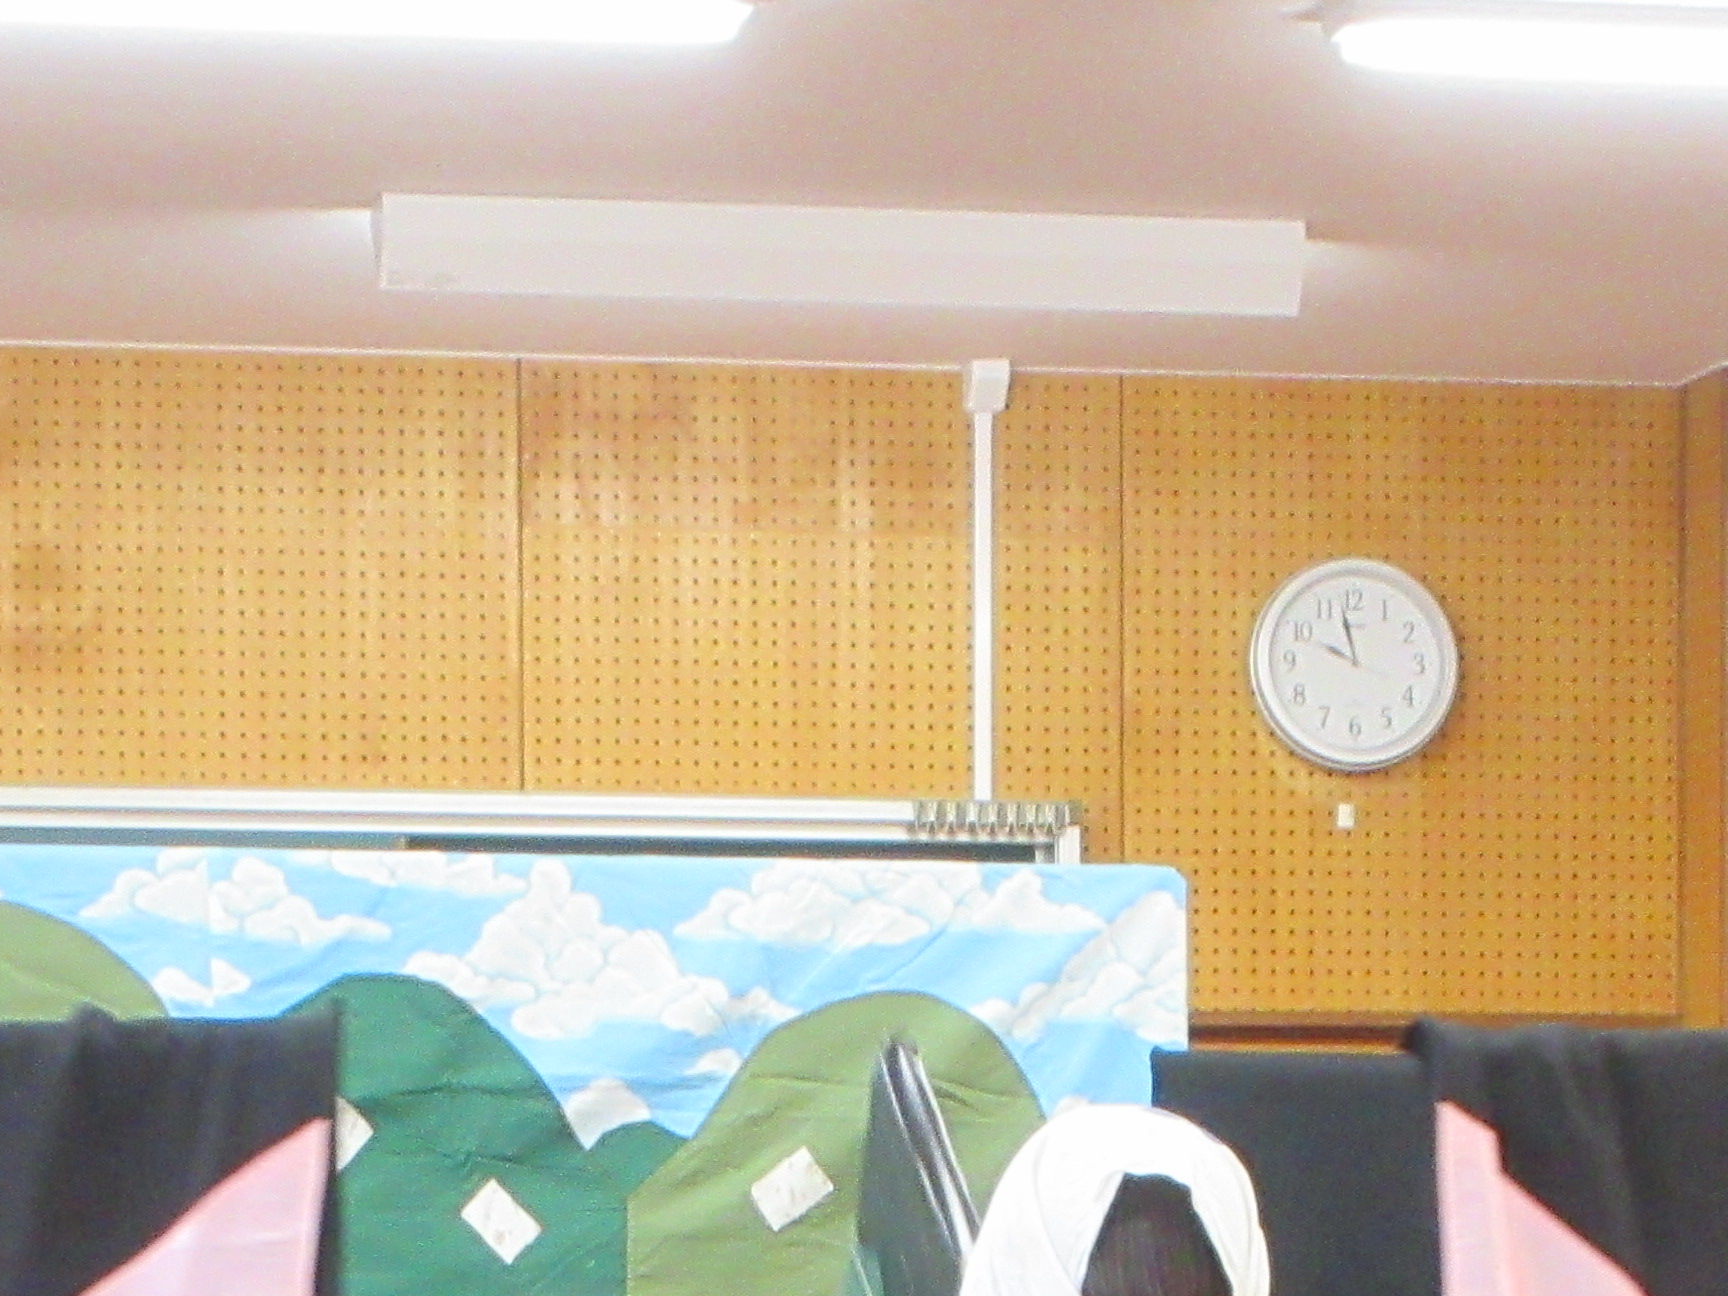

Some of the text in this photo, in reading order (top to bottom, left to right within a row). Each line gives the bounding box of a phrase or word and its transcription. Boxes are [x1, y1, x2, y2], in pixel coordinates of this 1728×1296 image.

[1317, 600, 1332, 619] 11
[1344, 589, 1363, 611] 12
[1294, 621, 1313, 642] 10
[1403, 621, 1415, 643] 2
[1283, 650, 1297, 672] 9
[1414, 652, 1426, 674] 3
[1293, 683, 1306, 706] 8
[1402, 685, 1414, 708] 4
[1318, 706, 1331, 729] 7
[1349, 715, 1362, 738] 6
[1381, 706, 1393, 729] 5
